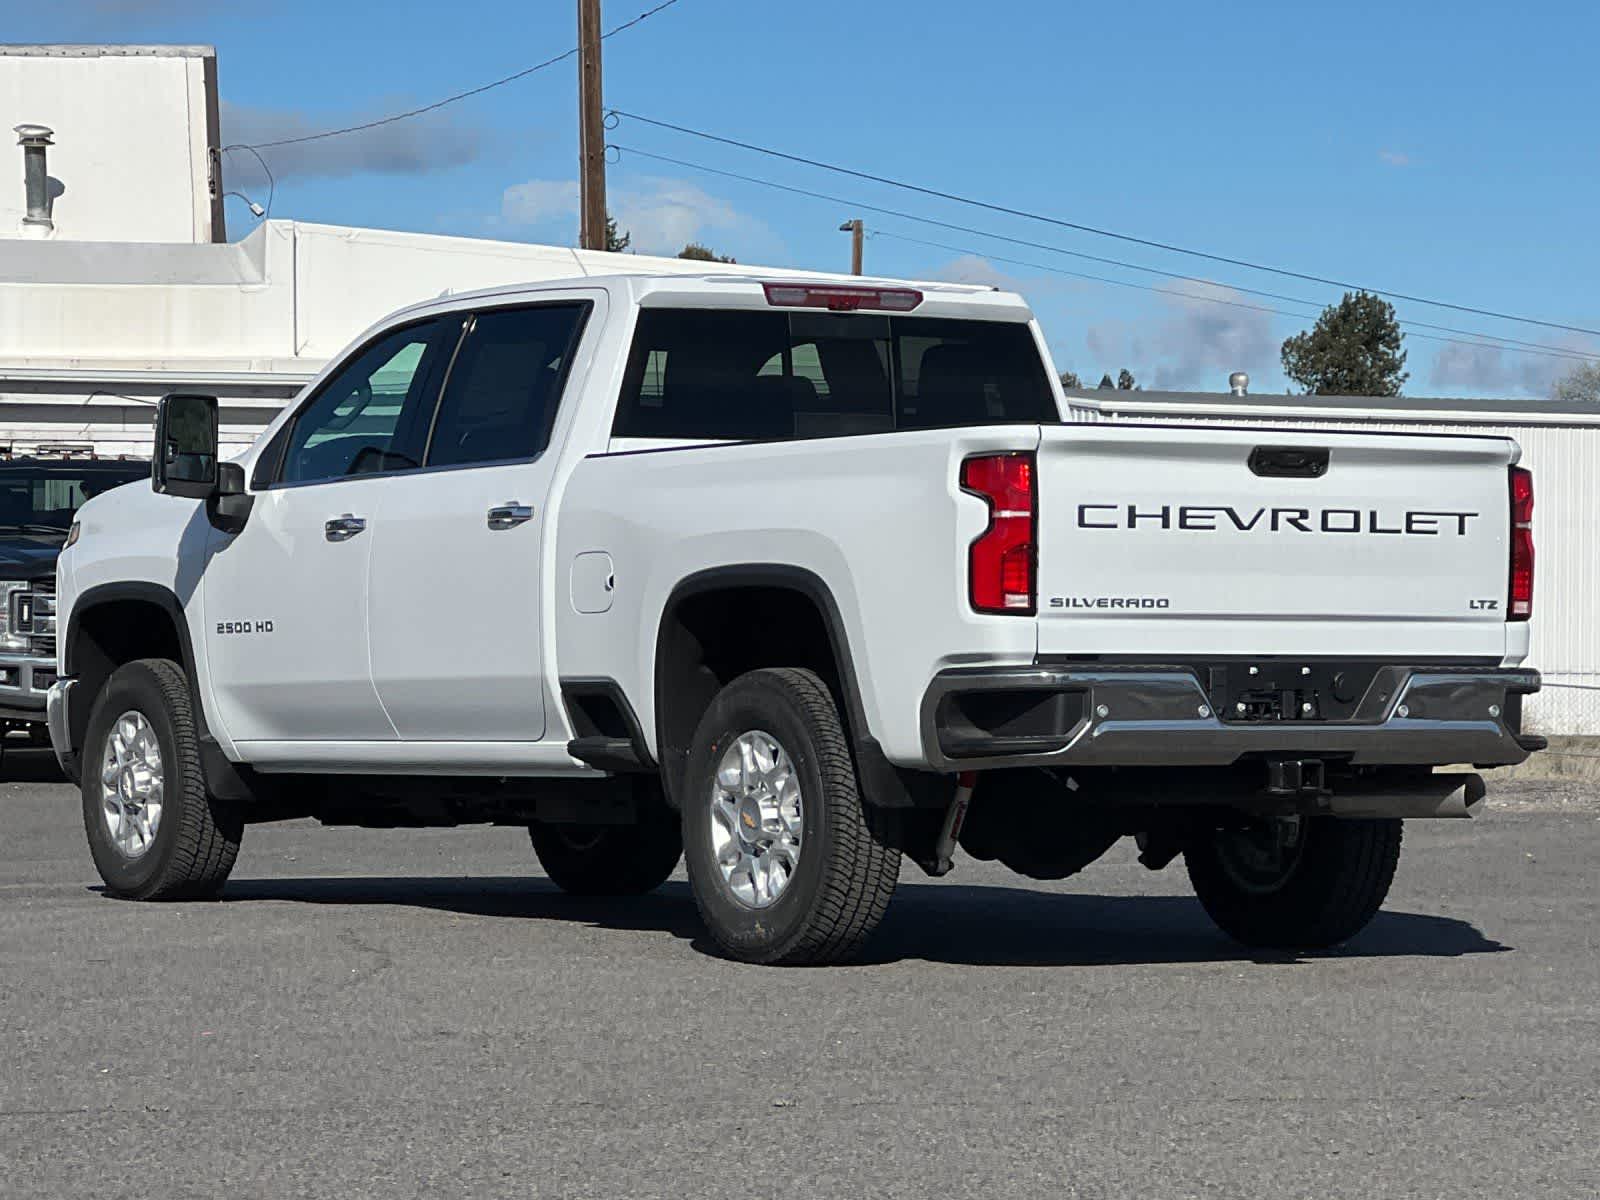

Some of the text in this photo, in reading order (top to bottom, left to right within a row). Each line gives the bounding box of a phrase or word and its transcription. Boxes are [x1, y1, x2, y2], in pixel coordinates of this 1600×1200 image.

[1077, 504, 1479, 536] CHEVROLET
[1050, 597, 1169, 608] SILVERADO
[1469, 599, 1498, 610] LTZ
[216, 620, 273, 634] 2500 HD
